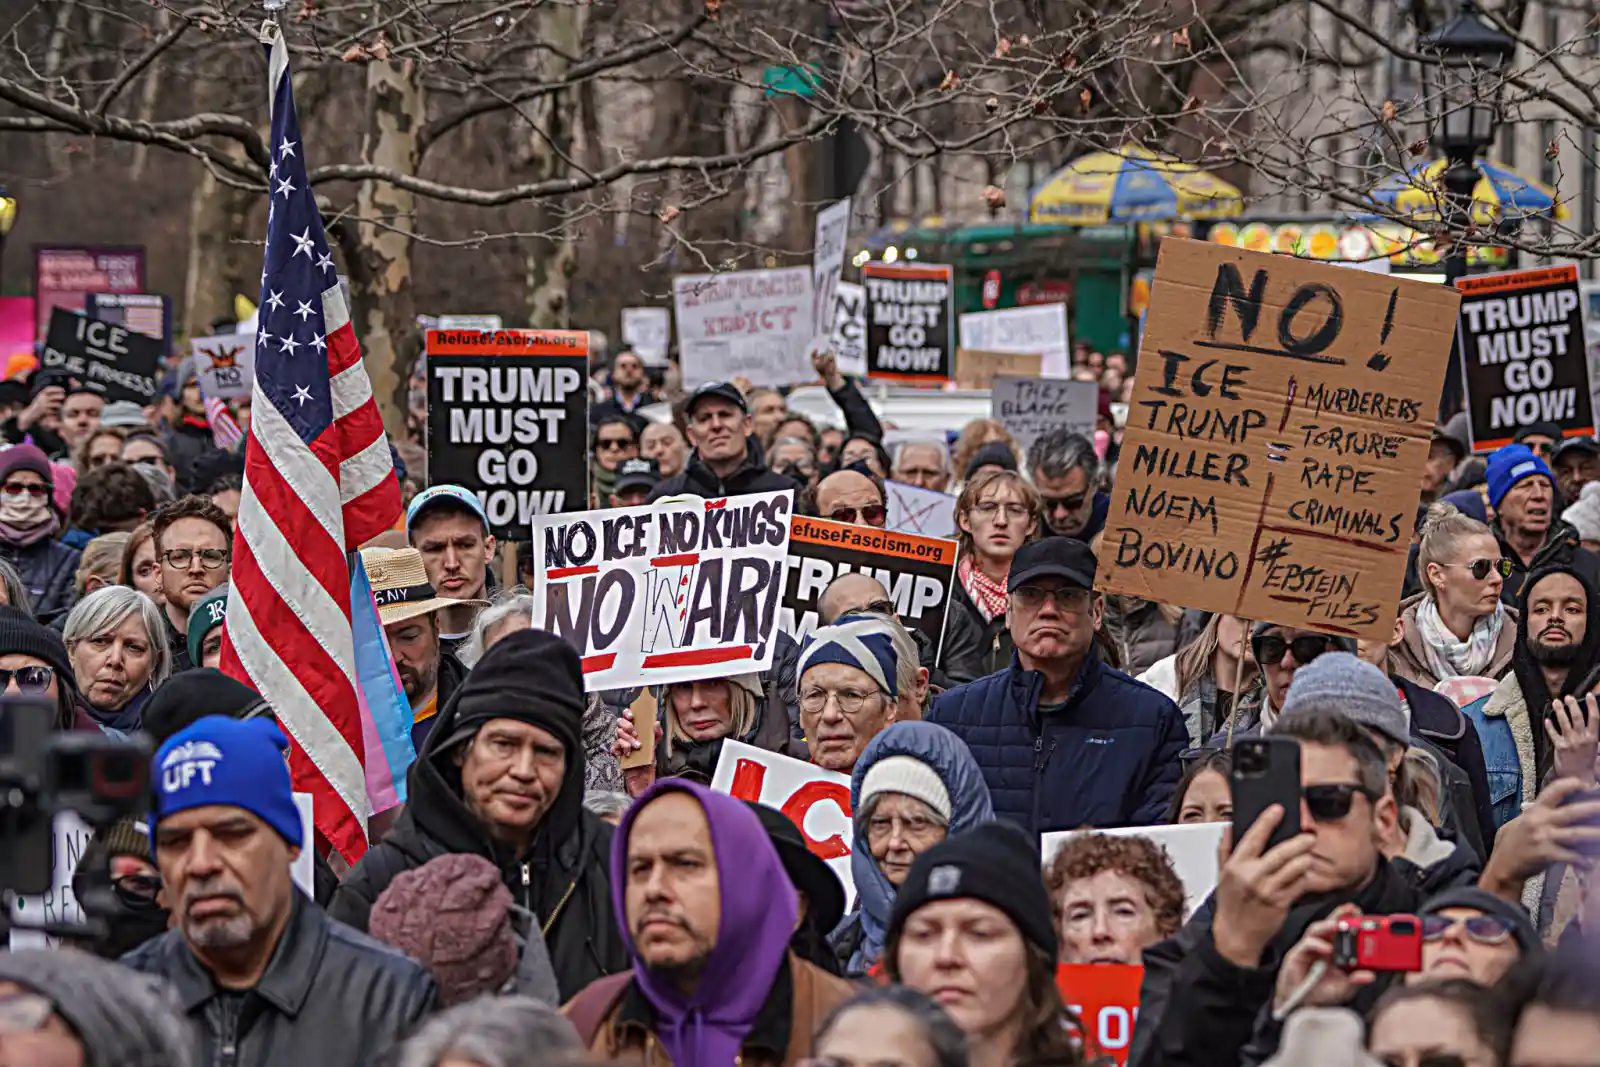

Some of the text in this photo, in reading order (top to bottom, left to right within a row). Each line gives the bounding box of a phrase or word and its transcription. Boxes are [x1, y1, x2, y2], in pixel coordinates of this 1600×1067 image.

[867, 279, 948, 302] TRUMP
[873, 302, 942, 327] MUST
[1461, 288, 1578, 333] TRUMP
[76, 318, 128, 354] ICE
[437, 331, 577, 348] RefuseFascism.org
[888, 325, 926, 348] GO
[1477, 324, 1571, 366] MUST
[216, 367, 241, 382] NO
[876, 345, 941, 371] NOW!
[1148, 349, 1252, 401] ICE
[1503, 358, 1554, 392] GO
[434, 366, 581, 403] TRUMP
[1012, 379, 1068, 403] THEY
[1304, 381, 1423, 424] MURDERERS
[450, 408, 566, 444] MUST
[1490, 387, 1576, 429] NOW!
[1139, 400, 1268, 446] TRUMP
[1300, 424, 1407, 460] TORTURE
[477, 448, 538, 486] GO
[1133, 444, 1250, 488] MILLER
[1301, 457, 1377, 494] RAPE
[1125, 484, 1219, 536] NOEM
[1287, 498, 1404, 543] CRIMINALS
[544, 494, 790, 569] NO ICE NO KINGS
[792, 522, 944, 562] efuseFascism.org
[1114, 527, 1239, 581] BOVINO
[387, 588, 408, 602] NY
[544, 568, 636, 657] NO
[641, 557, 783, 661] WAR!
[1305, 596, 1381, 626] FILES
[163, 760, 216, 793] UFT
[730, 758, 853, 862] IC
